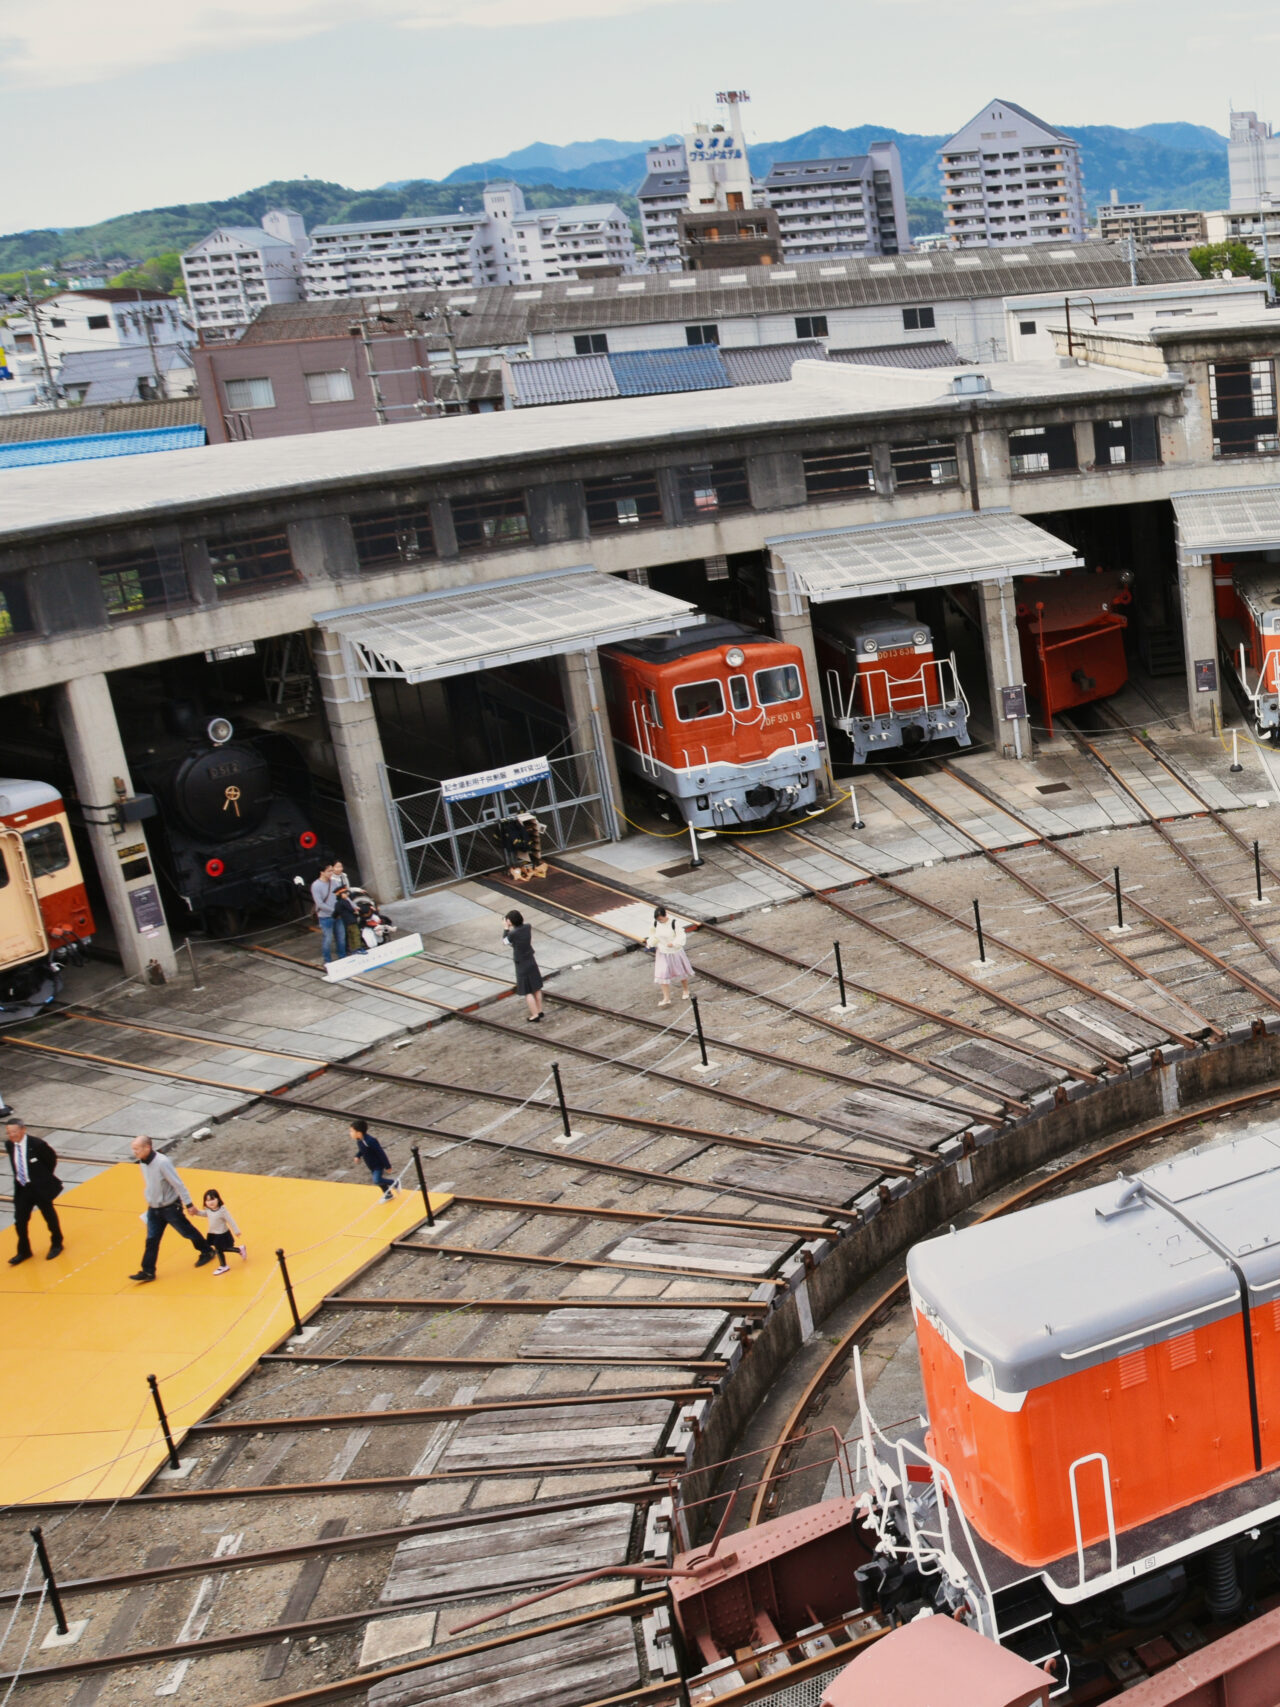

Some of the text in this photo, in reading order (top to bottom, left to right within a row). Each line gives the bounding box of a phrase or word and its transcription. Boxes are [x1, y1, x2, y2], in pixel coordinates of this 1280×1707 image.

[689, 149, 742, 162] グランドホテル
[791, 711, 801, 720] 18
